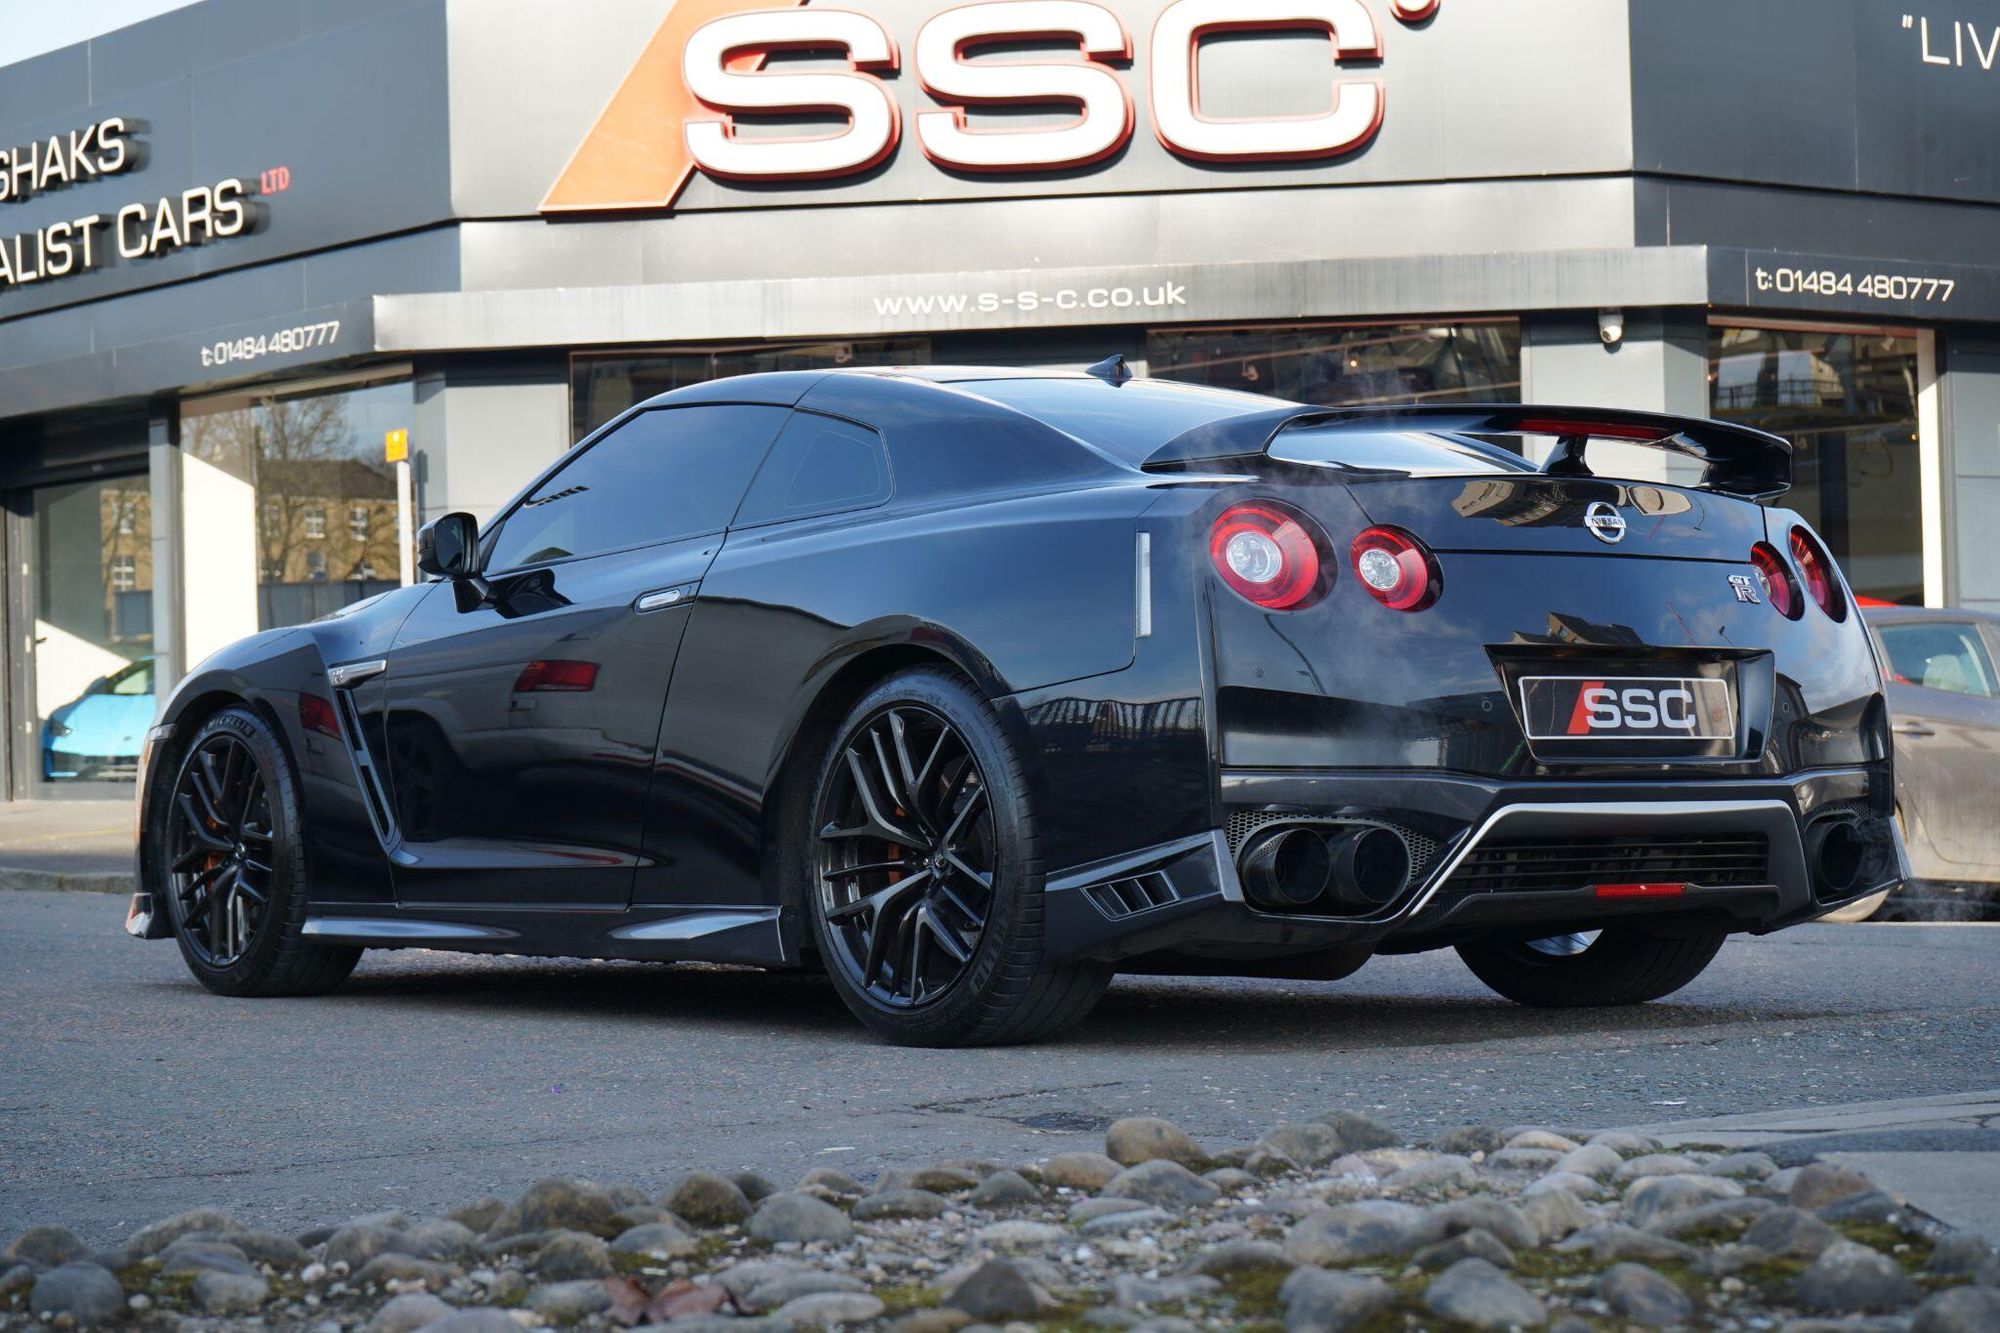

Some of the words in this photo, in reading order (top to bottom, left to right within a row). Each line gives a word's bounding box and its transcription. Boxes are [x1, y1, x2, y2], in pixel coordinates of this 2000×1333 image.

[681, 0, 1384, 180] SSC
[117, 178, 244, 259] CARS
[261, 166, 290, 195] LTD
[873, 281, 1186, 315] www.s-s-c.co.uk
[1857, 274, 1955, 302] 480777
[268, 320, 340, 353] 480777
[1591, 516, 1624, 527] NISSAN
[1583, 687, 1696, 728] SSC
